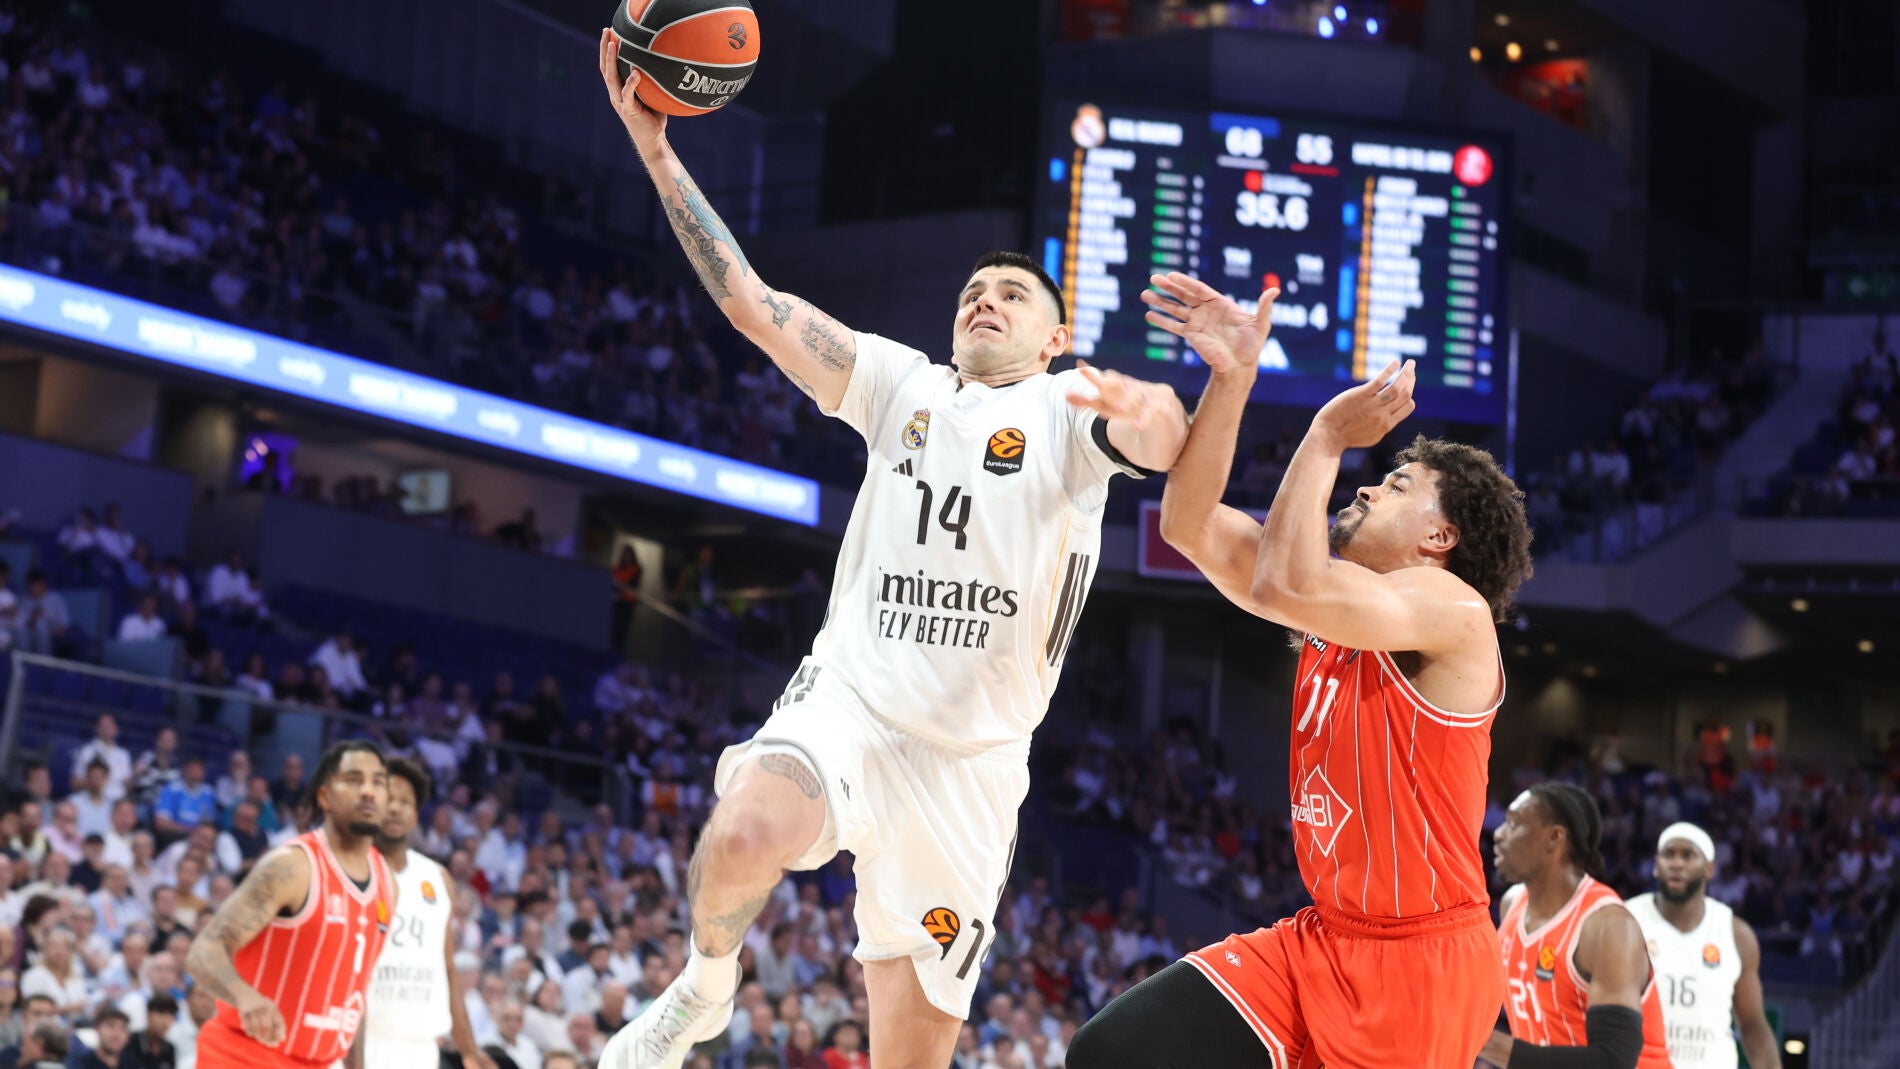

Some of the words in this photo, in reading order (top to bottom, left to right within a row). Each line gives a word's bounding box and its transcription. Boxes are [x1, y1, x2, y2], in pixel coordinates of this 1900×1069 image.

[1296, 133, 1333, 165] 55
[1235, 191, 1309, 231] 35.6
[986, 460, 1020, 469] EuroLeague
[916, 479, 972, 551] 14
[877, 566, 1018, 617] mirates
[878, 609, 912, 640] FLY
[915, 614, 990, 649] BETTER
[1297, 674, 1340, 737] 11
[391, 913, 424, 949] 24
[354, 932, 366, 974] 1
[1509, 978, 1542, 1023] 21
[1665, 975, 1696, 1008] 16
